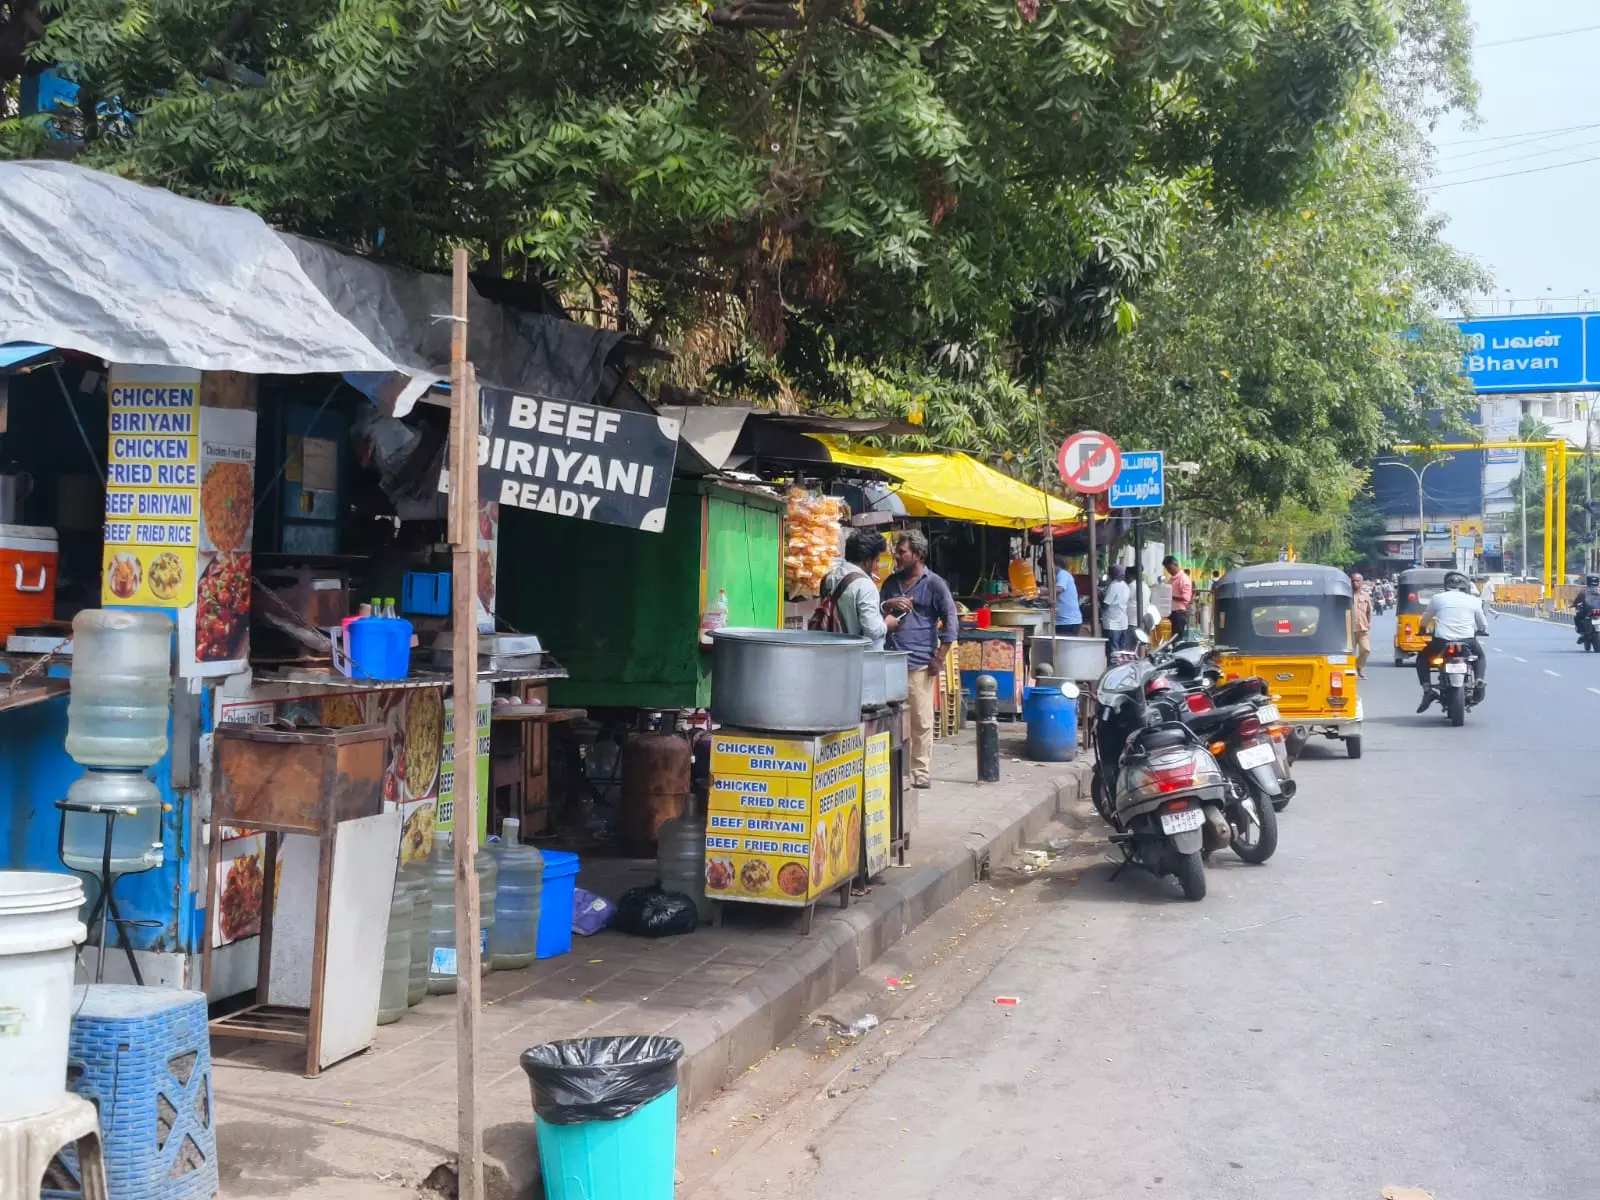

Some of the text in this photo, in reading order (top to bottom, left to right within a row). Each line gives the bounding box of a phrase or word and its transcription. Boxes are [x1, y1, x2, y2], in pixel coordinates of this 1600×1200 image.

[1492, 330, 1561, 349] பவன்
[1469, 355, 1559, 372] Bhavan
[111, 388, 193, 407] CHICKEN
[111, 413, 191, 432] BIRIYANI
[508, 395, 622, 444] BEEF
[114, 438, 188, 458] CHICKEN
[107, 464, 196, 484] FRIED RICE
[477, 435, 654, 498] BIRIYANI
[105, 494, 192, 515] BEEF BIRIYANI
[499, 479, 600, 520] READY
[104, 524, 192, 543] BEEF FRIED RICE
[716, 743, 774, 755] CHICKEN
[750, 759, 807, 772] BIRIYANI
[815, 767, 837, 790] CHICKEN
[838, 762, 852, 781] FRIED
[852, 758, 864, 775] RICE
[740, 796, 805, 810] FRIED RICE
[819, 794, 834, 814] BEEF
[834, 783, 857, 807] BIRIYANI
[439, 802, 453, 823] BEEF
[711, 816, 805, 833] BEEF BIRIYANI
[706, 837, 809, 854] BEEF FRIED RICE
